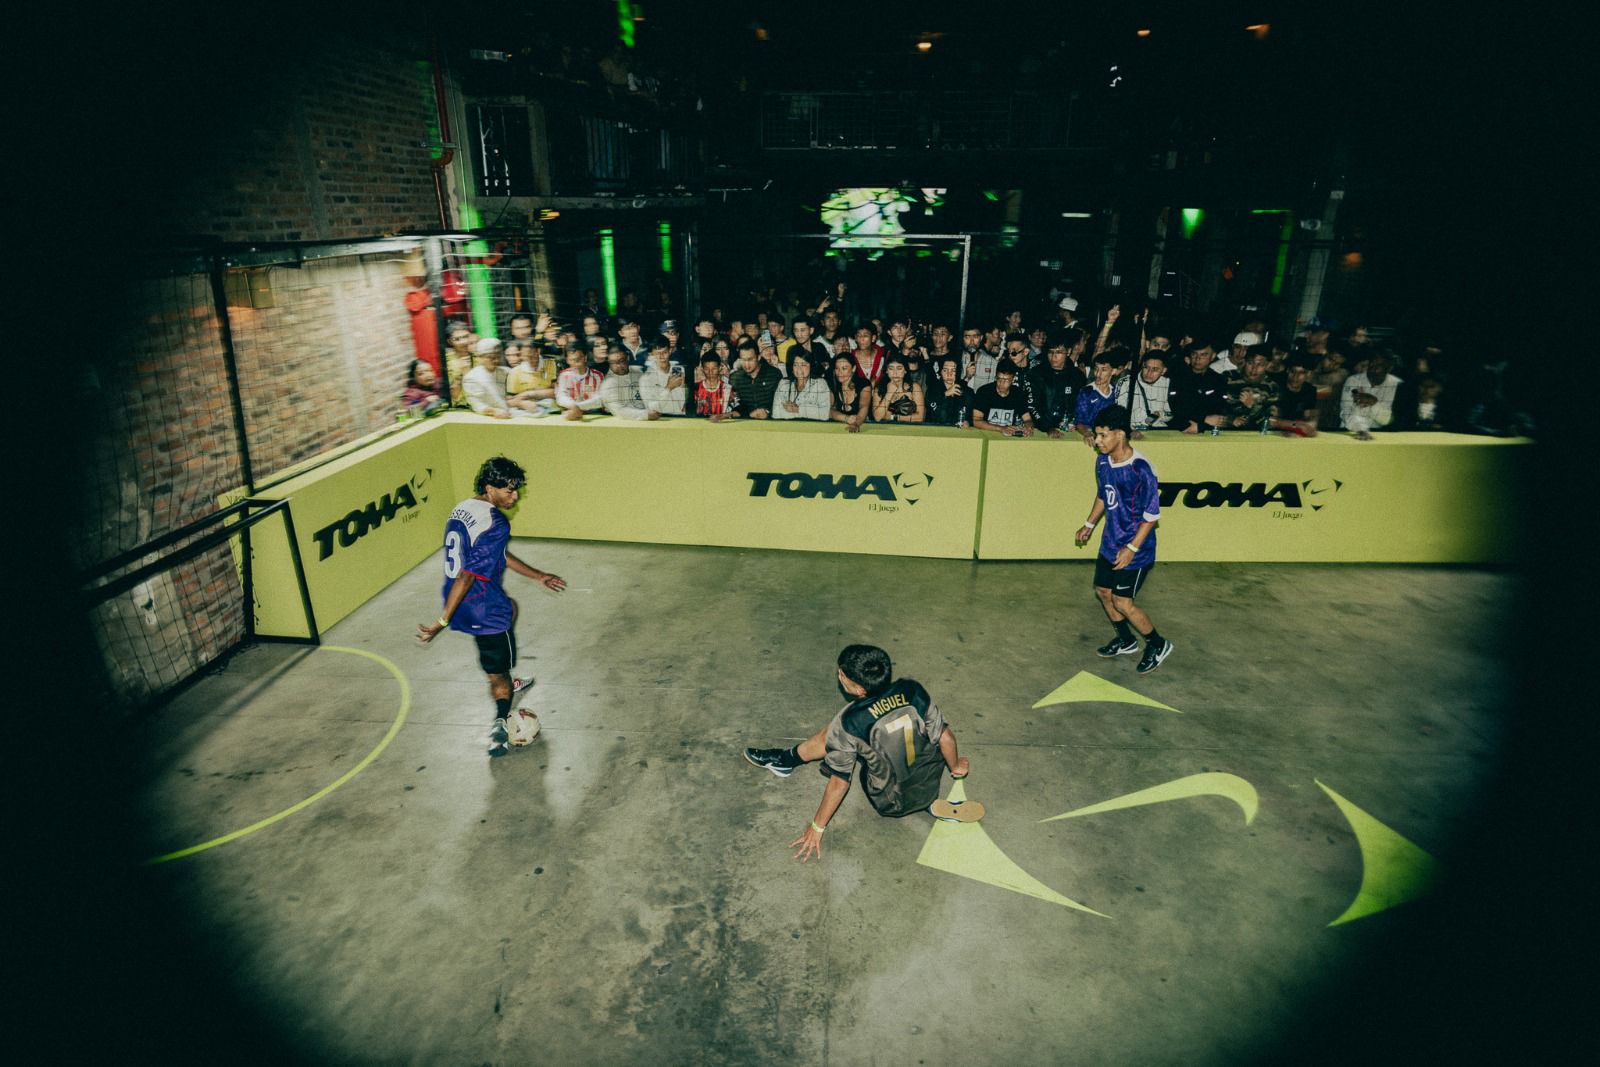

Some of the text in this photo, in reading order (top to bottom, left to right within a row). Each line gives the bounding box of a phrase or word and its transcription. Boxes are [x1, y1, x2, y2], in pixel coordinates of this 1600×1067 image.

[746, 472, 898, 501] TOMA
[1158, 481, 1303, 508] TOMA
[313, 483, 417, 562] TOMA
[444, 531, 462, 579] 3
[868, 694, 909, 719] MIGUEL
[885, 713, 916, 768] 7
